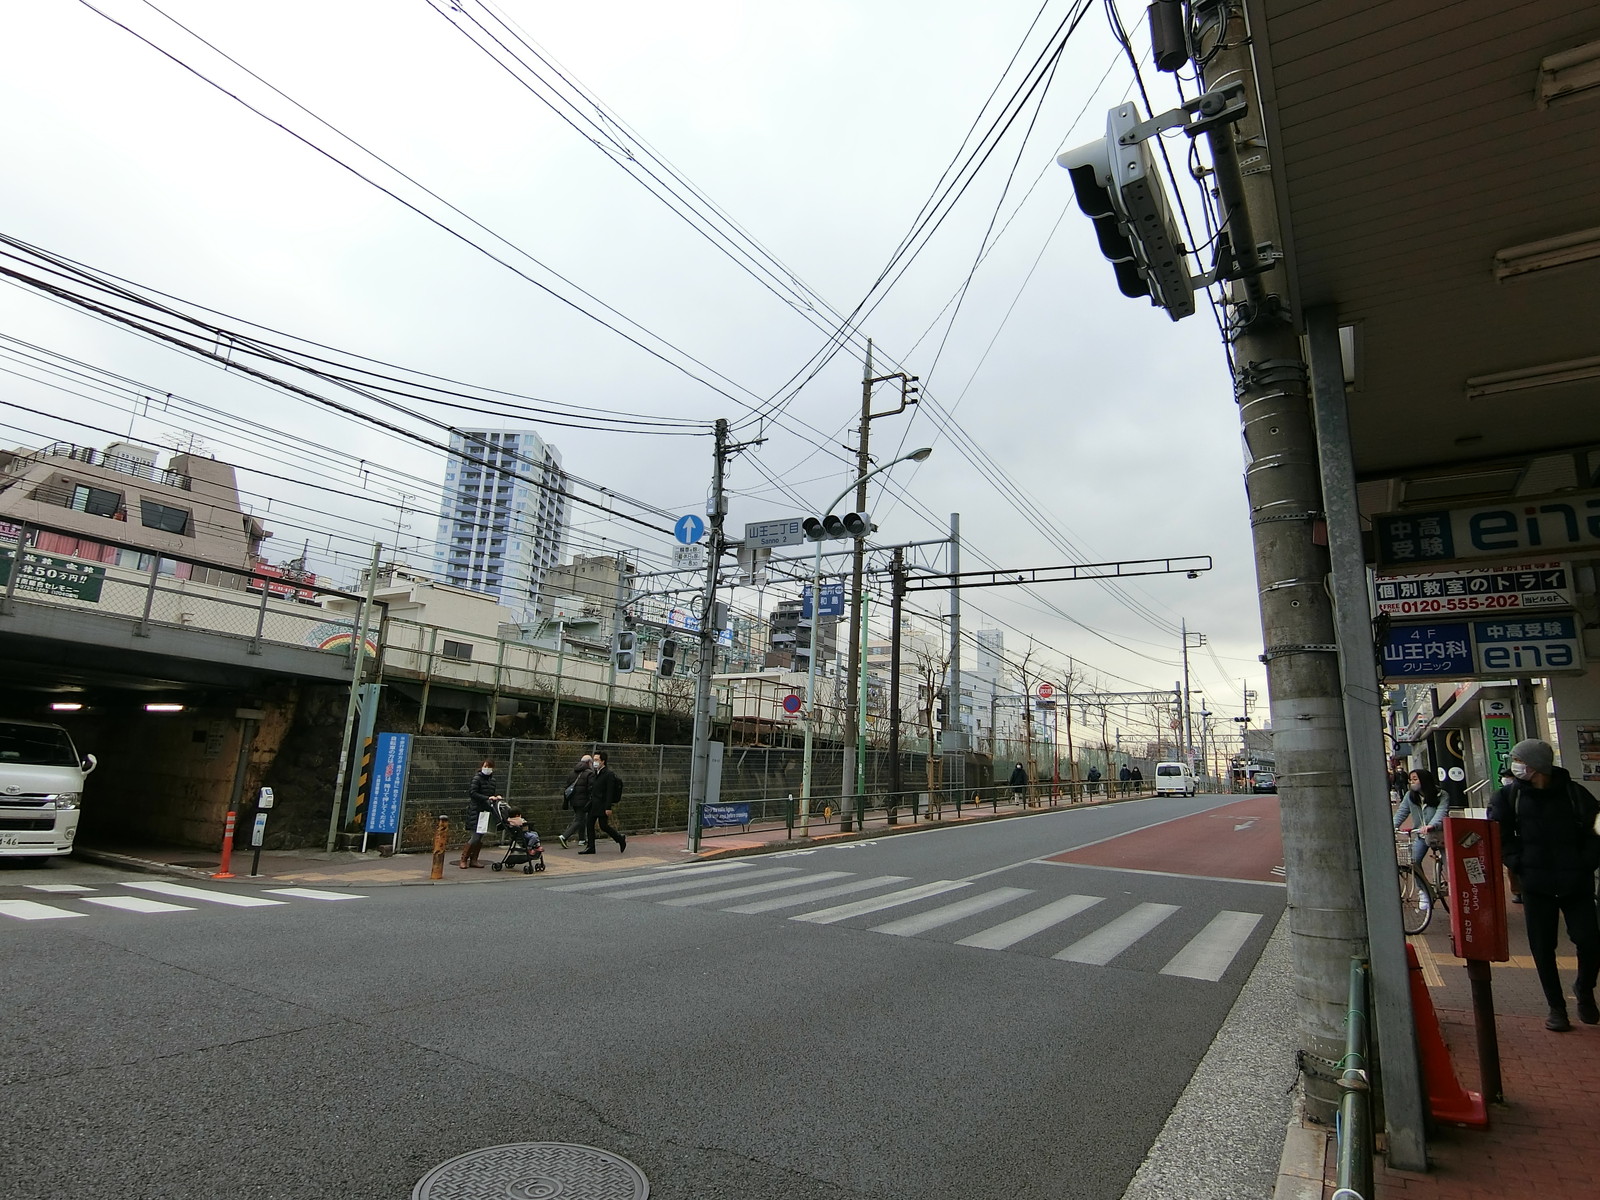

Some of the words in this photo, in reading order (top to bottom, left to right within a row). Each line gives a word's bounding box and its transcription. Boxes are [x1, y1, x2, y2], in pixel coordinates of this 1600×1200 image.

[750, 522, 799, 538] 山王二丁目
[1378, 572, 1560, 599] 個別教室のトライ
[1401, 594, 1519, 613] 0120-555-202
[1487, 621, 1562, 639] 中高受験
[1383, 640, 1468, 660] 山王内科
[1402, 661, 1452, 672] クリニック
